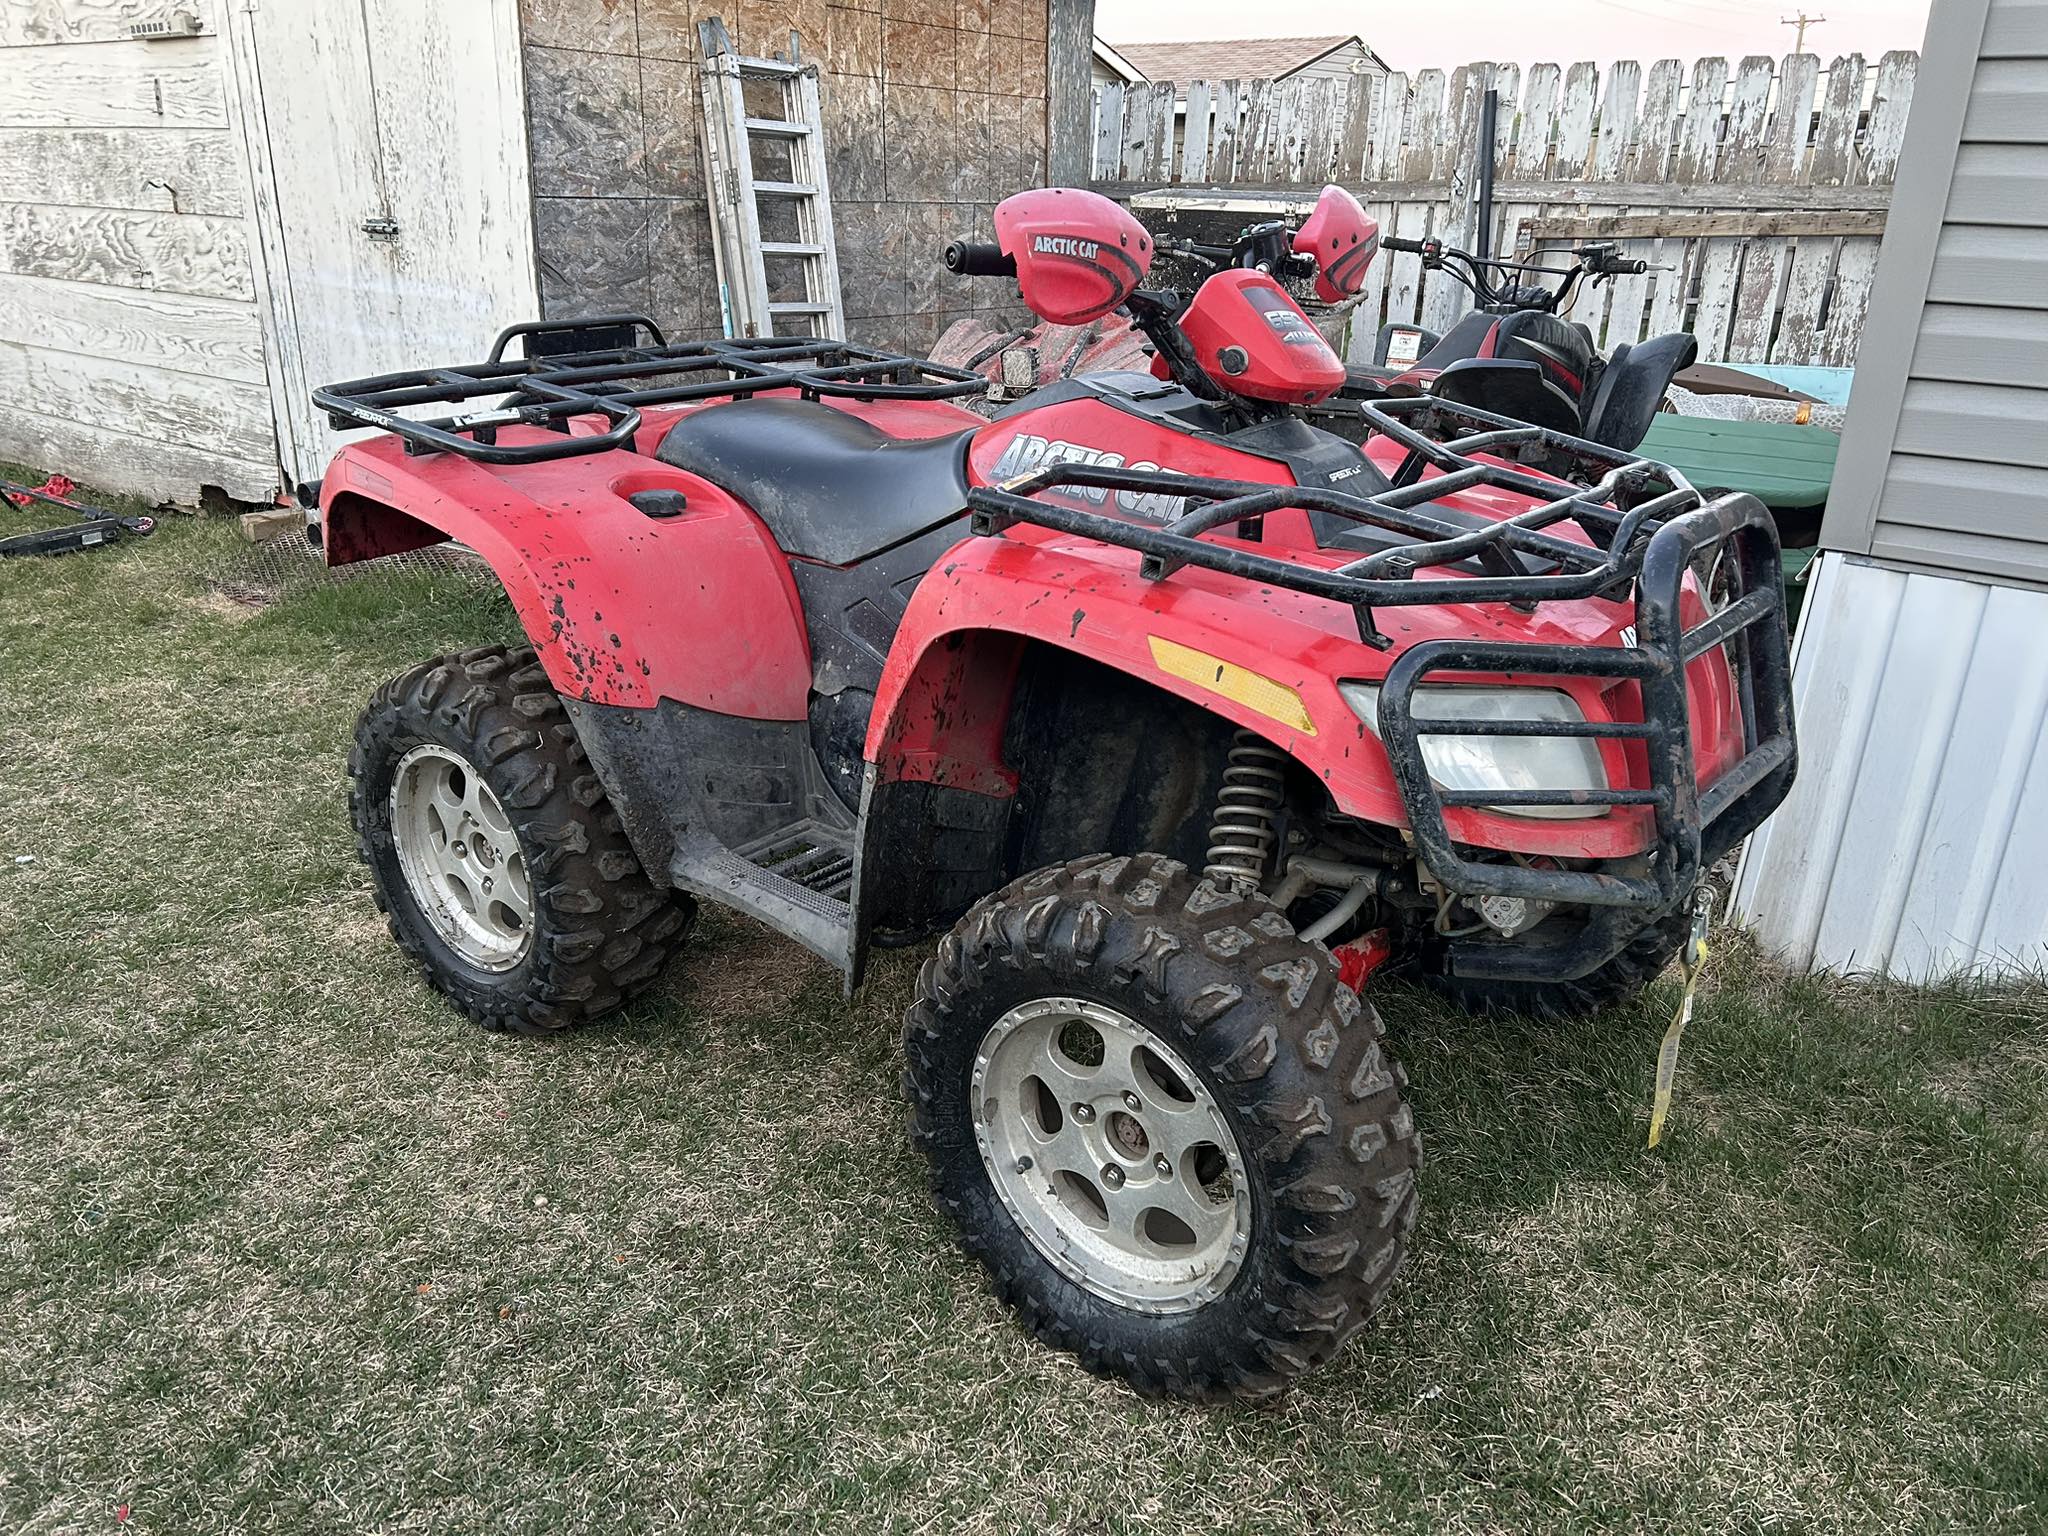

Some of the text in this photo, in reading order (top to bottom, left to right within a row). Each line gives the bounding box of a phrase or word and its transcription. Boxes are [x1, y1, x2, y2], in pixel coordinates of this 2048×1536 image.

[1034, 236, 1099, 259] ARCTIC CAT
[989, 433, 1125, 505] ARCTIC
[1618, 622, 1637, 648] AR
